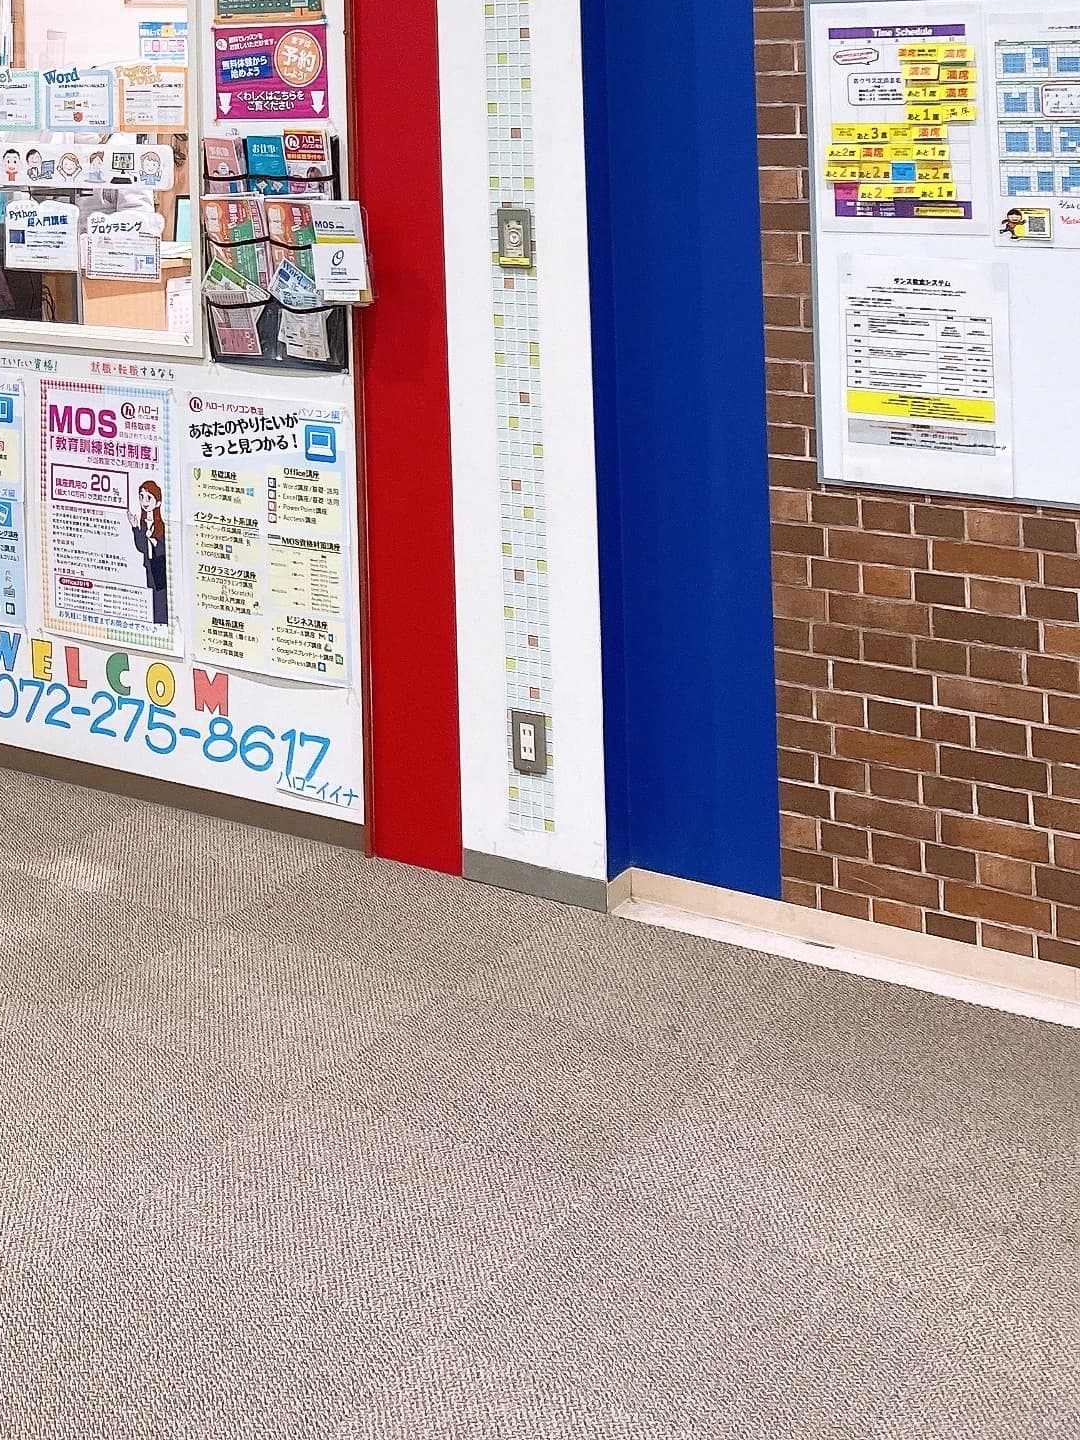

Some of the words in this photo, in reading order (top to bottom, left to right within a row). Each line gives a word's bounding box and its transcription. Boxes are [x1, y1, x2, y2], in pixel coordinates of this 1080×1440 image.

[872, 28, 893, 37] Time
[895, 27, 933, 37] Schedule
[281, 45, 317, 72] 予約
[43, 68, 80, 85] Word
[230, 66, 261, 79] 始めよう
[236, 91, 305, 101] くわしくはこちらを
[247, 100, 295, 112] ご覧ください
[9, 208, 37, 221] Python
[91, 221, 142, 234] プログラミング
[315, 220, 335, 229] MOS
[49, 404, 117, 439] MOS
[189, 412, 299, 439] あなたのやりたいが
[50, 435, 158, 461] 「教育訓練給付制度」
[201, 434, 298, 458] きっと見つかる!
[283, 467, 320, 479] Office講座
[91, 473, 111, 492] 20
[194, 511, 259, 528] インターネット系講座
[197, 563, 257, 580] プログラミング講座
[286, 615, 328, 631] ビジネス講座
[276, 771, 359, 807] ハローイイナ
